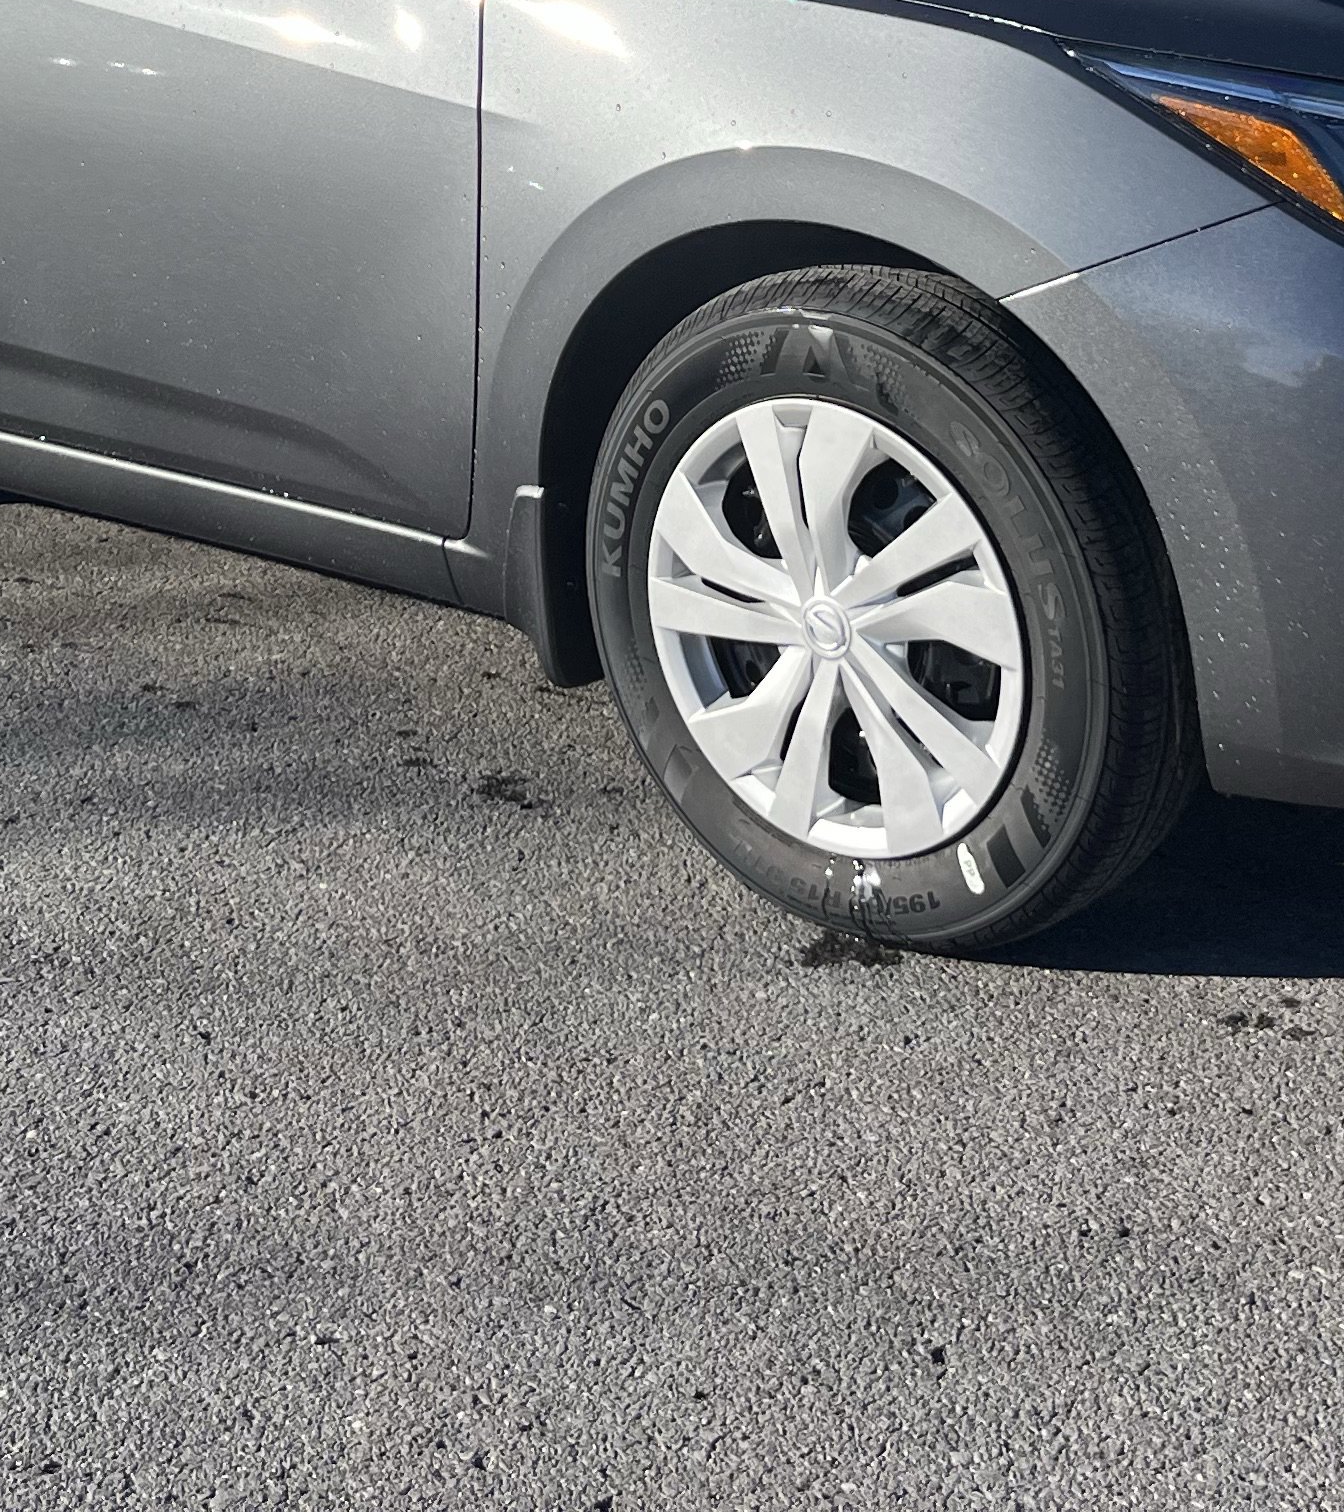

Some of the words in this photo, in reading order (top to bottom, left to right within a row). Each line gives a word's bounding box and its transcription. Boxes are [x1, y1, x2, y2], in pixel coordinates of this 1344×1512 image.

[602, 399, 671, 578] KUMHO
[949, 421, 1067, 621] SOLUS
[852, 889, 941, 916] 195/
